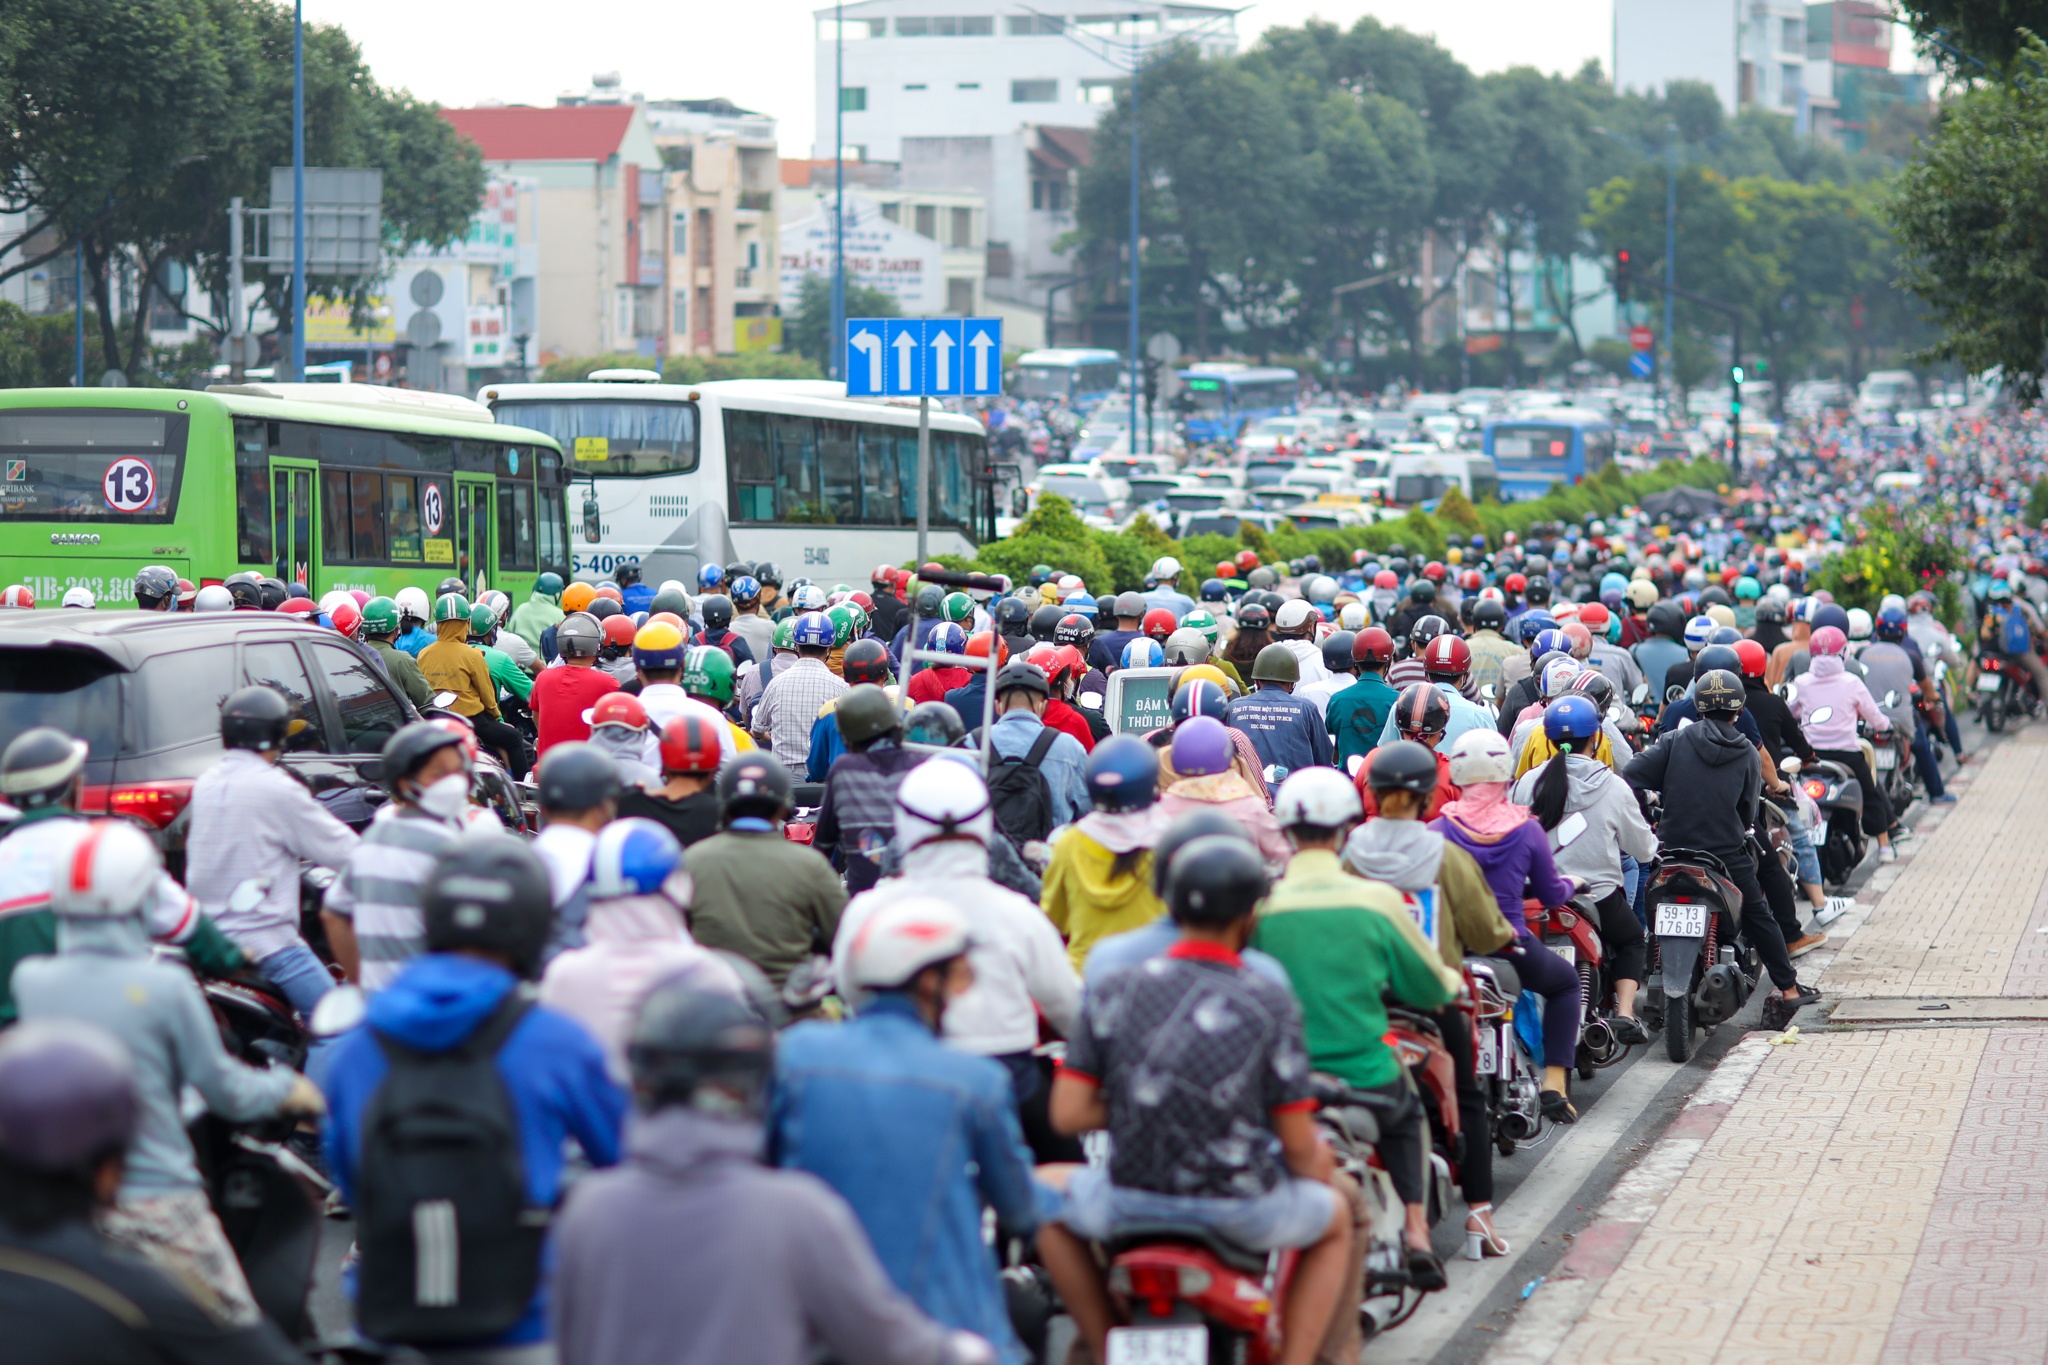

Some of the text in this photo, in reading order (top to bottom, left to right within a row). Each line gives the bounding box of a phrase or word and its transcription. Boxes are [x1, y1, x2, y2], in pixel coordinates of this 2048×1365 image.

[108, 466, 149, 503] 13
[426, 492, 440, 525] 13
[50, 534, 100, 545] SAMCO
[837, 621, 849, 638] Grab
[1135, 697, 1171, 713] ĐẬM V
[1128, 714, 1174, 728] THỜI GIA
[1664, 907, 1698, 920] 59-Y3
[1659, 921, 1701, 934] 176.05
